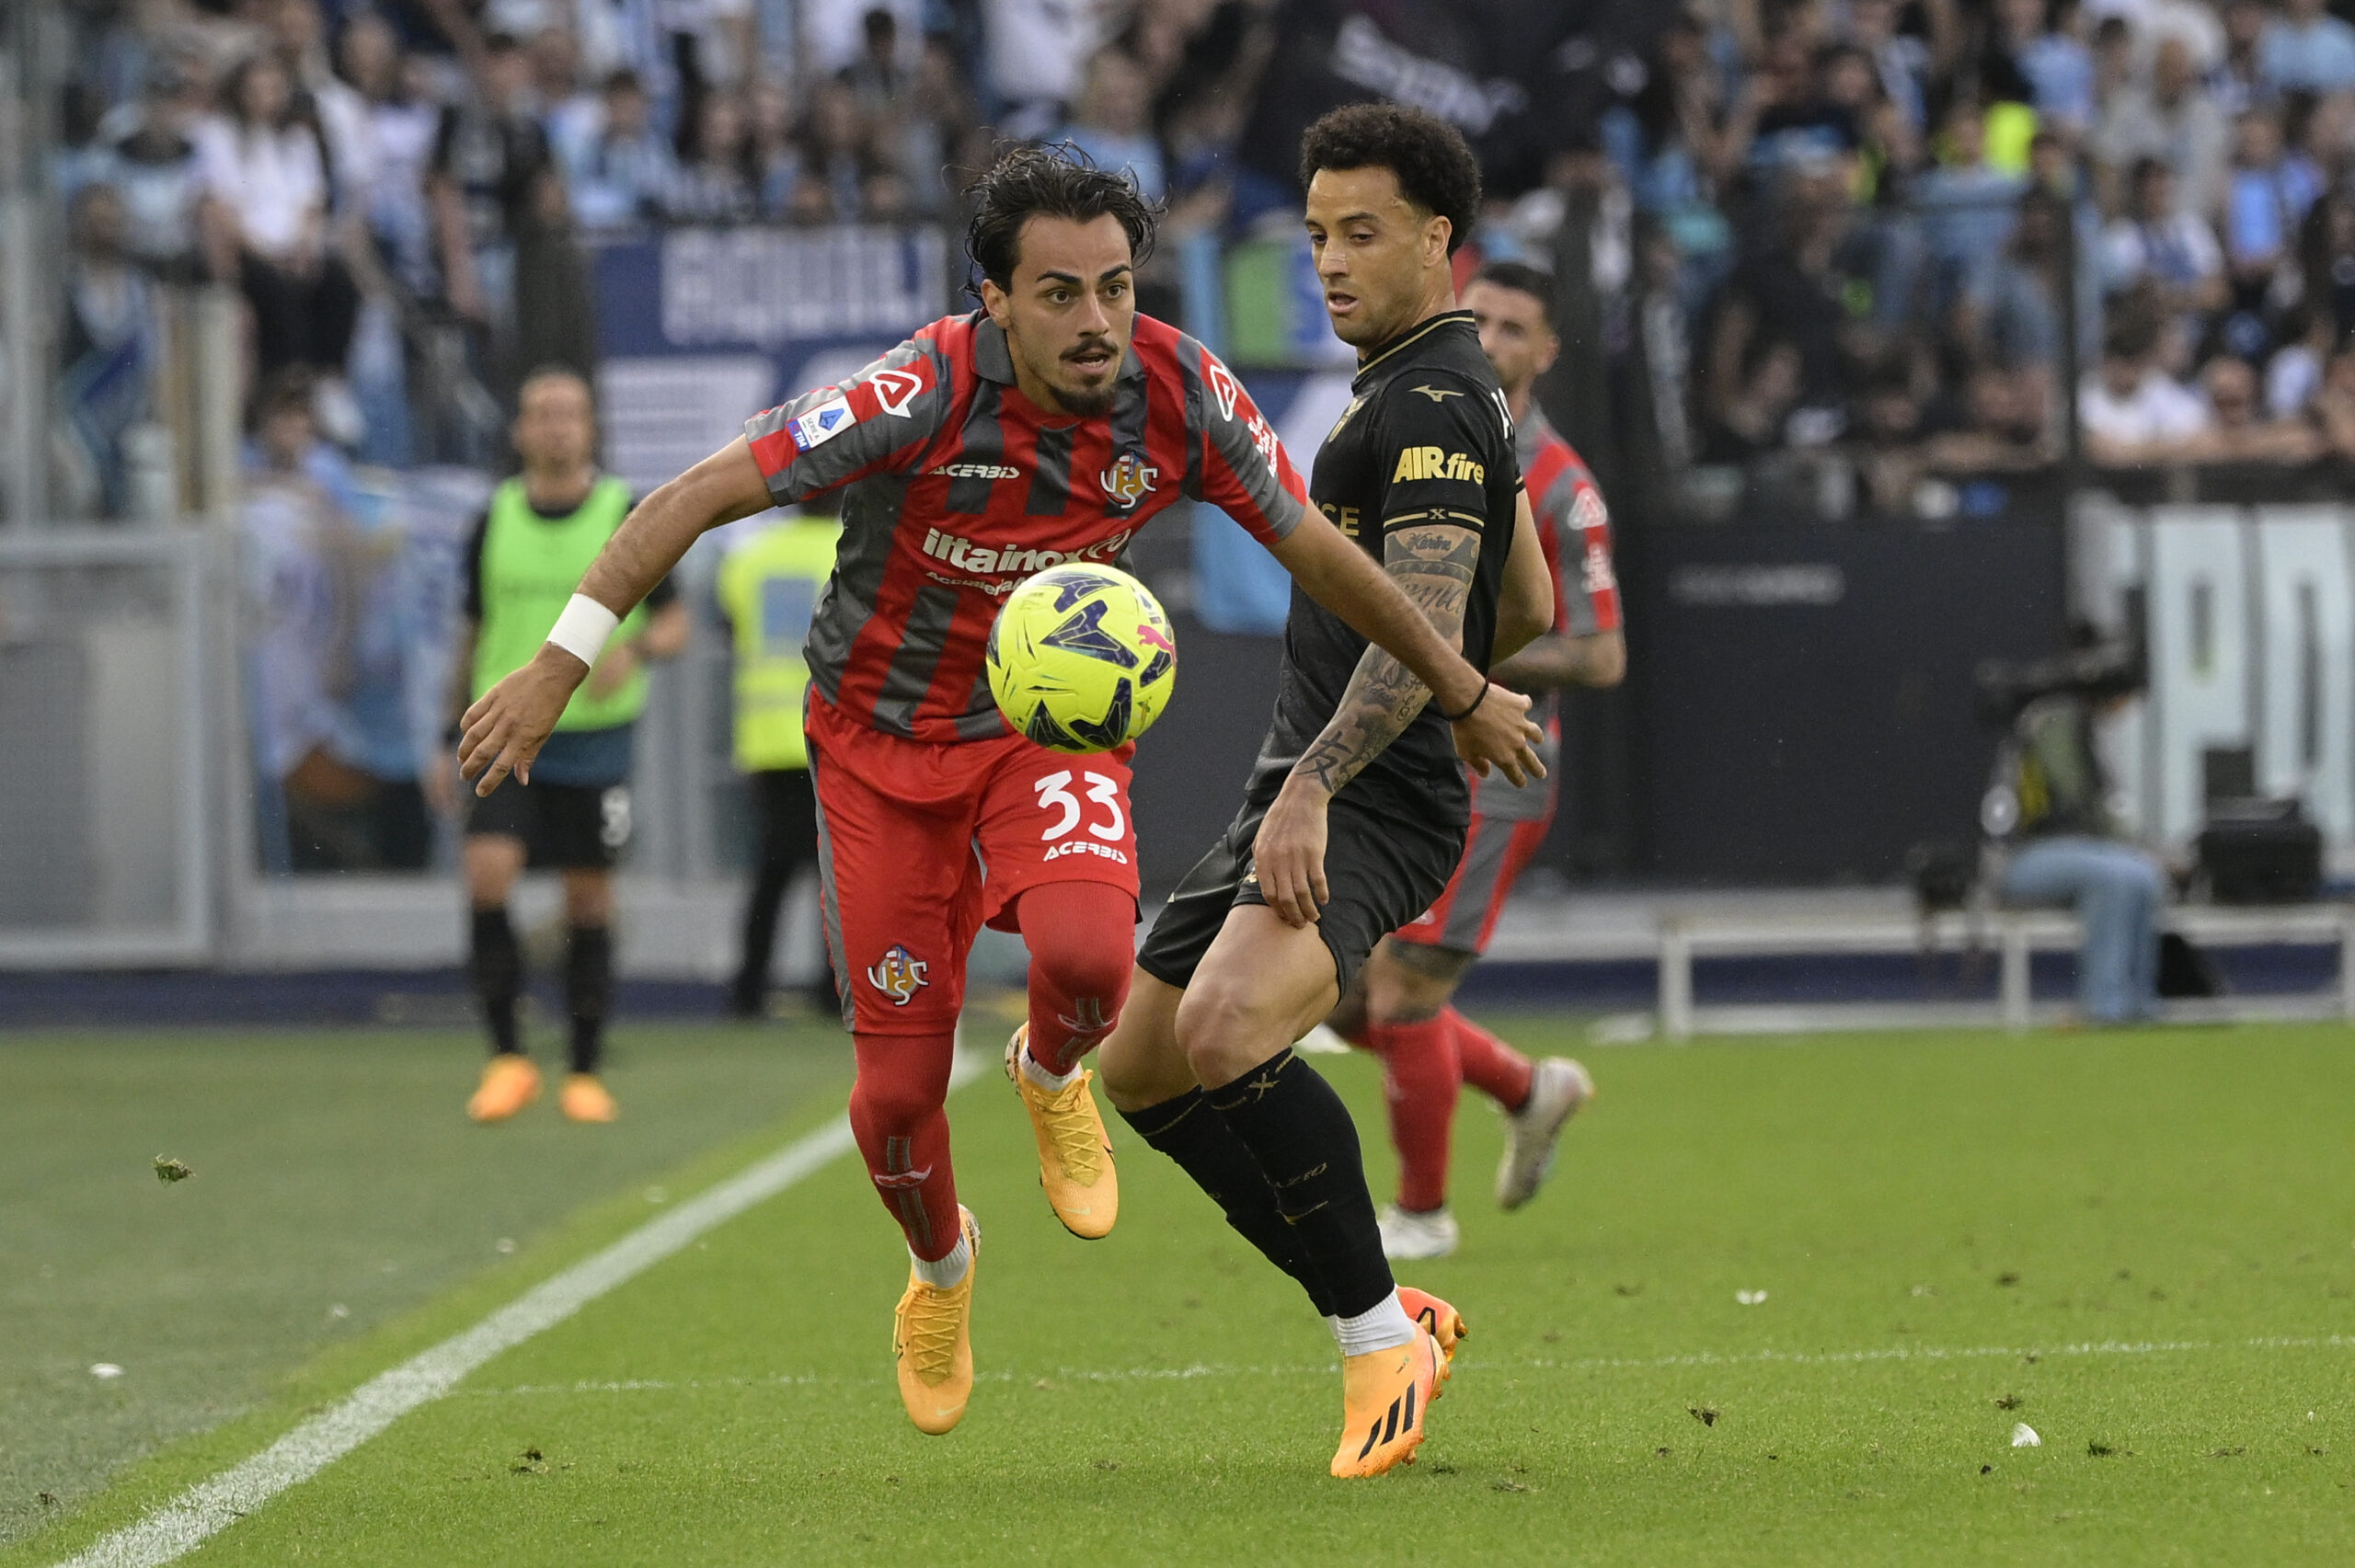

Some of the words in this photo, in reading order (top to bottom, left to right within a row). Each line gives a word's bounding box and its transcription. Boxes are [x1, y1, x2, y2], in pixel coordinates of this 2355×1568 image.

[794, 430, 808, 449] TIM
[927, 464, 1020, 479] ACERBIS
[1034, 770, 1125, 841] 33
[1042, 841, 1128, 864] ACERBIS
